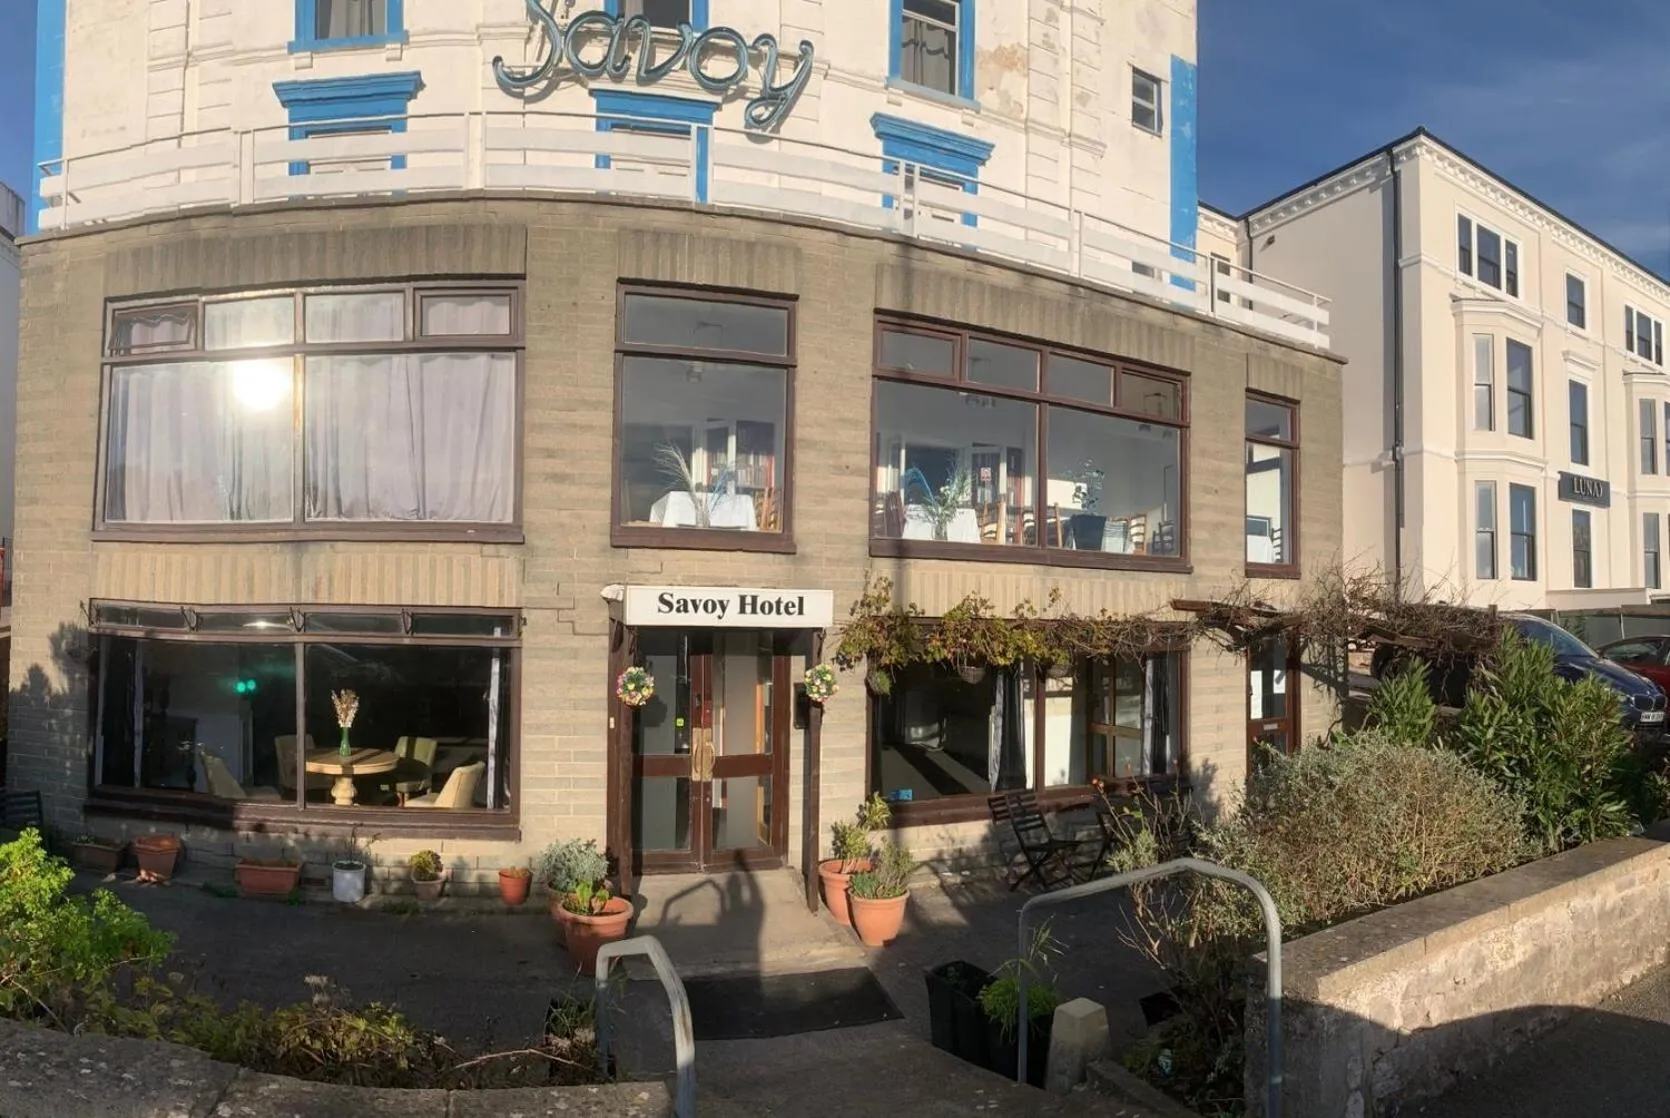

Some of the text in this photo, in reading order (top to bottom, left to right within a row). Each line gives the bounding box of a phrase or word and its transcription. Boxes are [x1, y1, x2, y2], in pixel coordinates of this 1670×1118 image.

[493, 0, 815, 129] Savoy
[657, 592, 805, 619] Savoy Hotel
